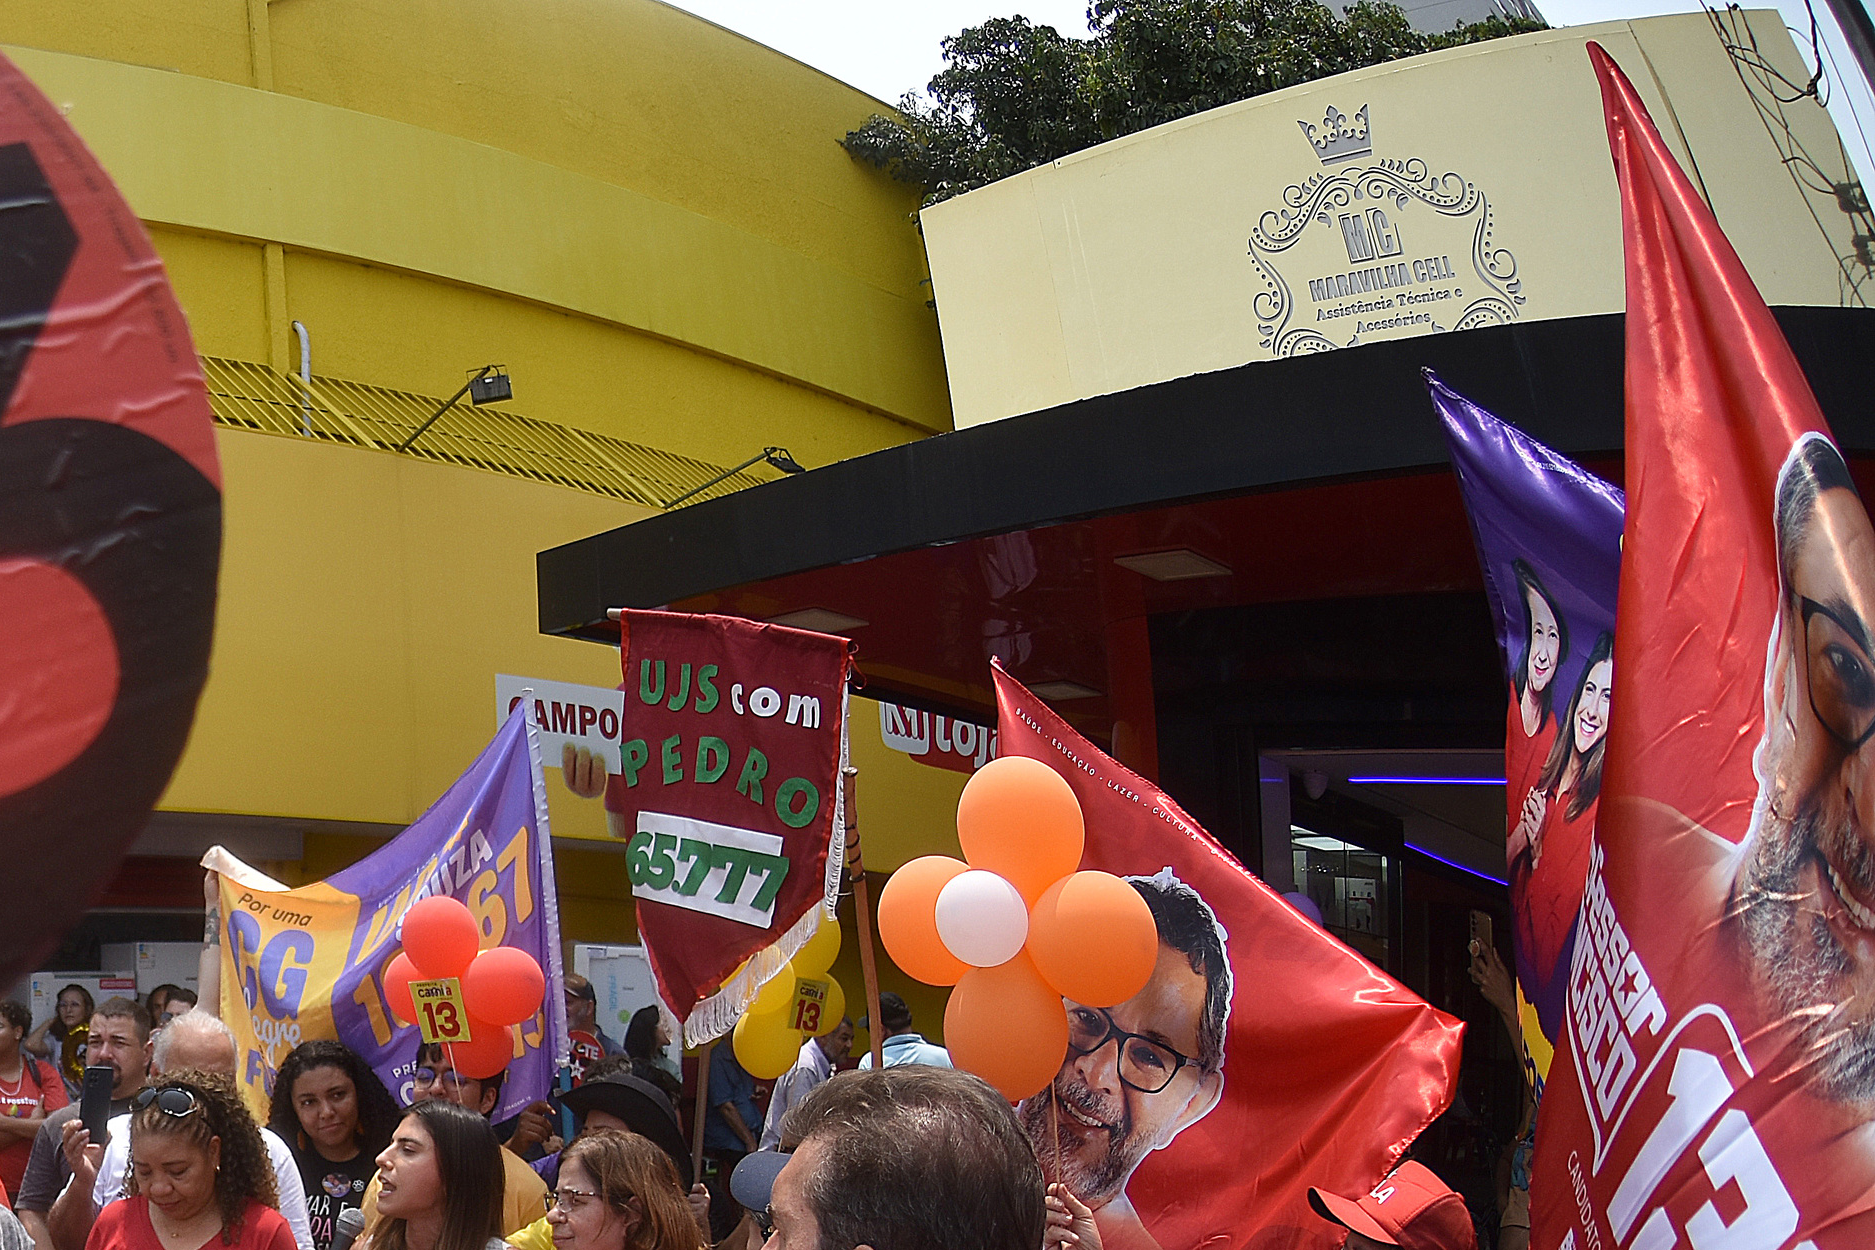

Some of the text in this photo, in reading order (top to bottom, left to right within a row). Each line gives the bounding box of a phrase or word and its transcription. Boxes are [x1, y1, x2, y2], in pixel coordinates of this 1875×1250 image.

[1308, 255, 1456, 302] MARAVILHA CELL
[1316, 287, 1463, 321] Assistência Técnica e
[1355, 311, 1432, 334] Acessórios
[639, 659, 720, 713] UJS
[730, 683, 821, 729] com
[509, 697, 619, 741] AMPO
[619, 734, 820, 829] PEDRO
[1015, 707, 1042, 734] SAÚDE
[1051, 737, 1096, 776] EDUCAÇÃO
[1107, 779, 1139, 803] LAZER
[1152, 806, 1197, 841] CULTURA
[626, 831, 790, 913] 65.777
[237, 892, 313, 927] Por uma
[227, 908, 315, 1020] CG
[422, 1001, 461, 1039] 13
[794, 999, 821, 1032] 13
